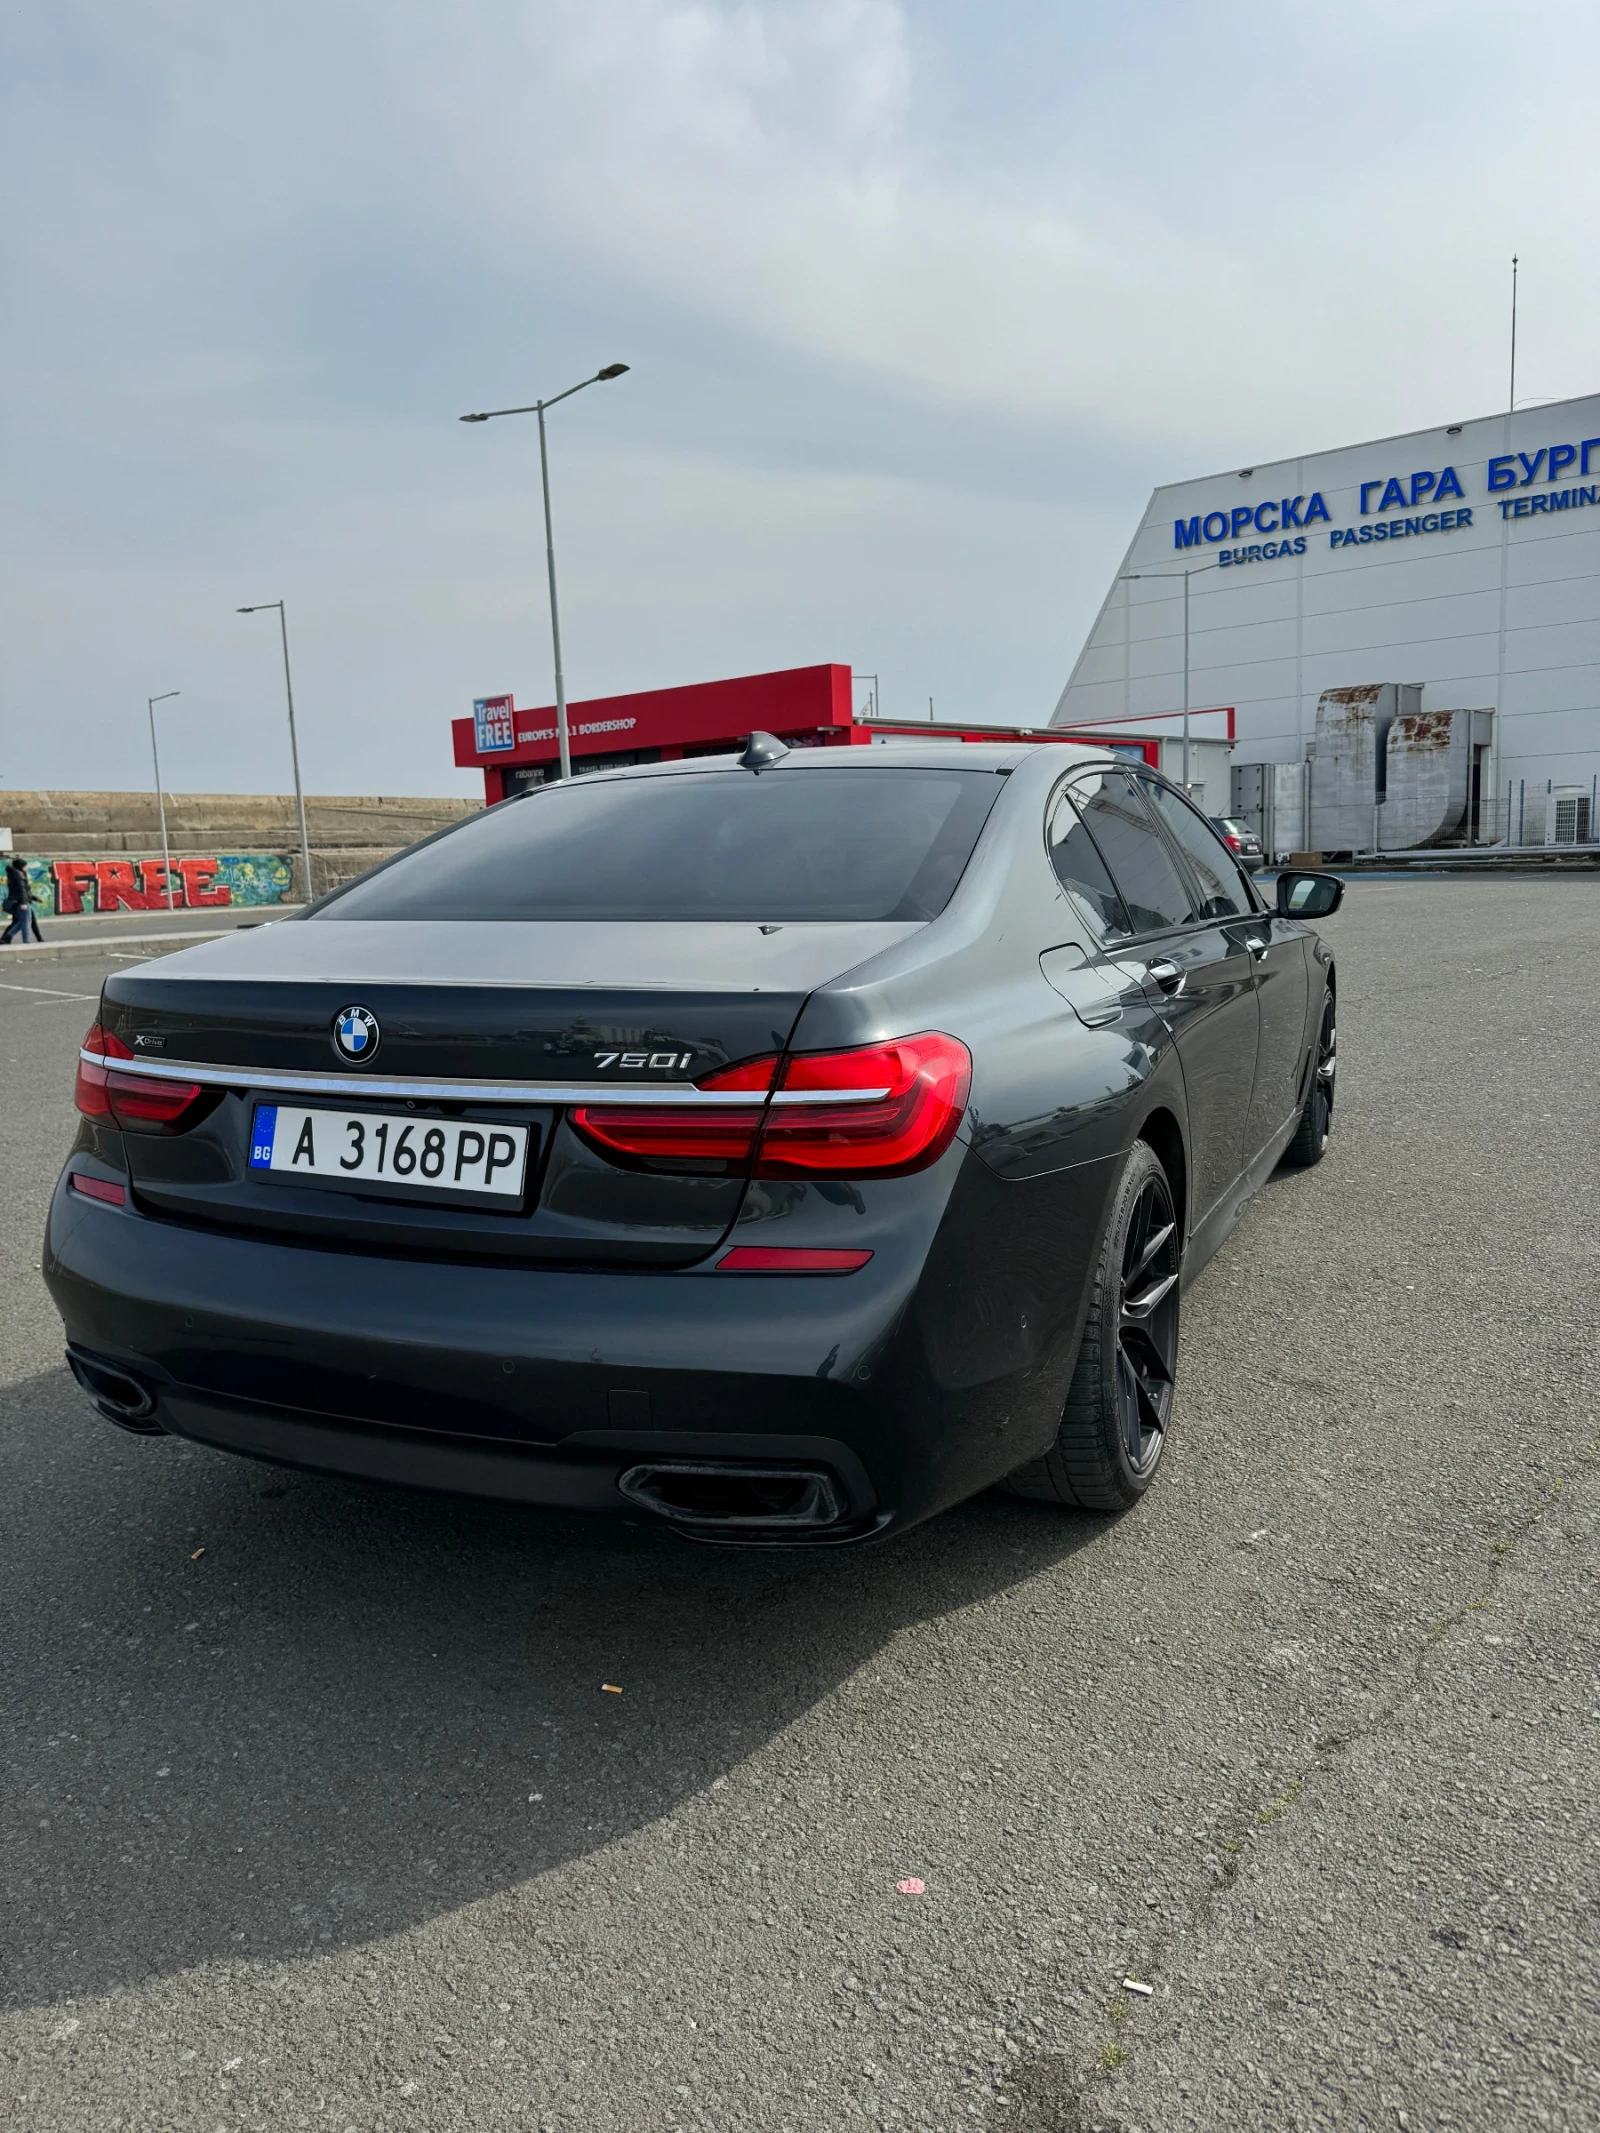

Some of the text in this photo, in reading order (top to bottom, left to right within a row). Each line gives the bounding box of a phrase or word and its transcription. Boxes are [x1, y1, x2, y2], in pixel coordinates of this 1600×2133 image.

[1174, 437, 1600, 549] МОРСКА ГАРА БУРГ
[1218, 485, 1600, 568] BURGAS PASSENGER TERMIN
[475, 699, 510, 722] Travel
[478, 722, 511, 748] FREE
[518, 729, 554, 743] EUROPE'S
[579, 718, 637, 735] BORDERSHOP
[52, 857, 231, 914] FREE
[338, 1009, 375, 1027] BMW
[593, 1052, 692, 1069] 750i
[253, 1146, 271, 1161] BG
[291, 1116, 315, 1166] A
